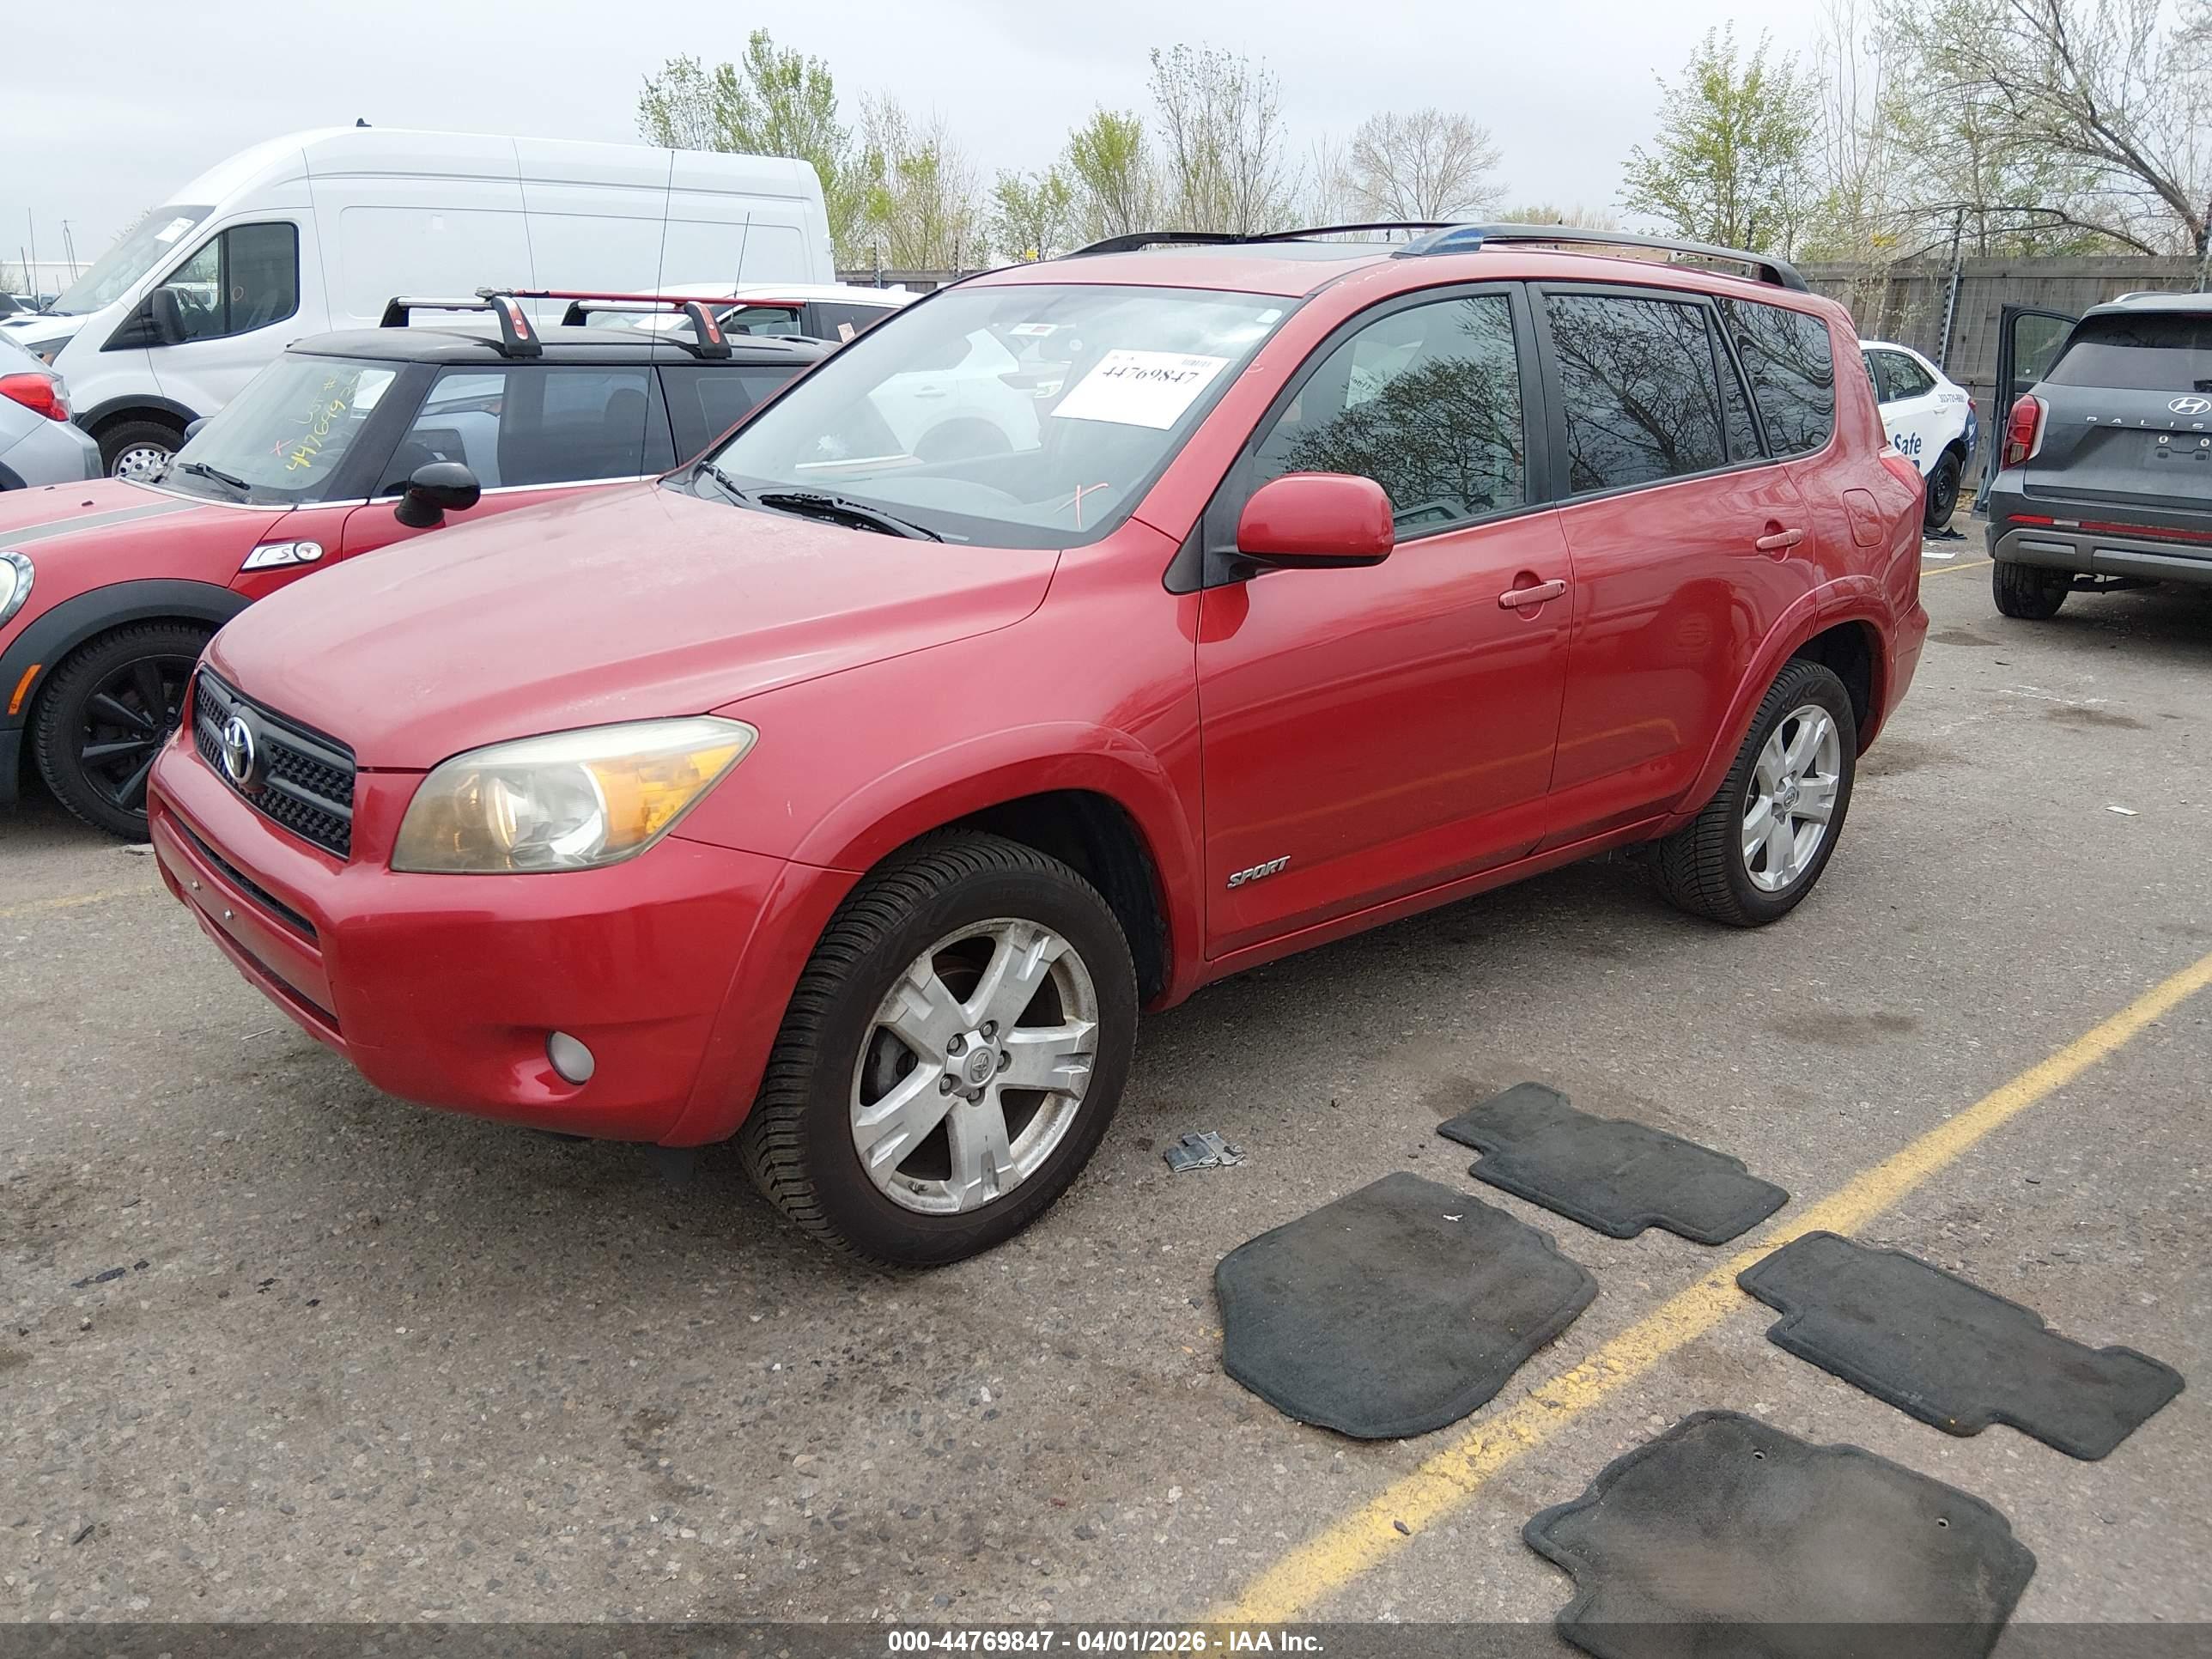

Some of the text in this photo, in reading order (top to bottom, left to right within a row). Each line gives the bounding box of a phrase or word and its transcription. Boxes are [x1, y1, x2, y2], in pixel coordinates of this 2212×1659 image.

[1103, 367, 1200, 385] 44769847
[1894, 432, 1922, 455] Safe
[1226, 854, 1291, 889] SPORT
